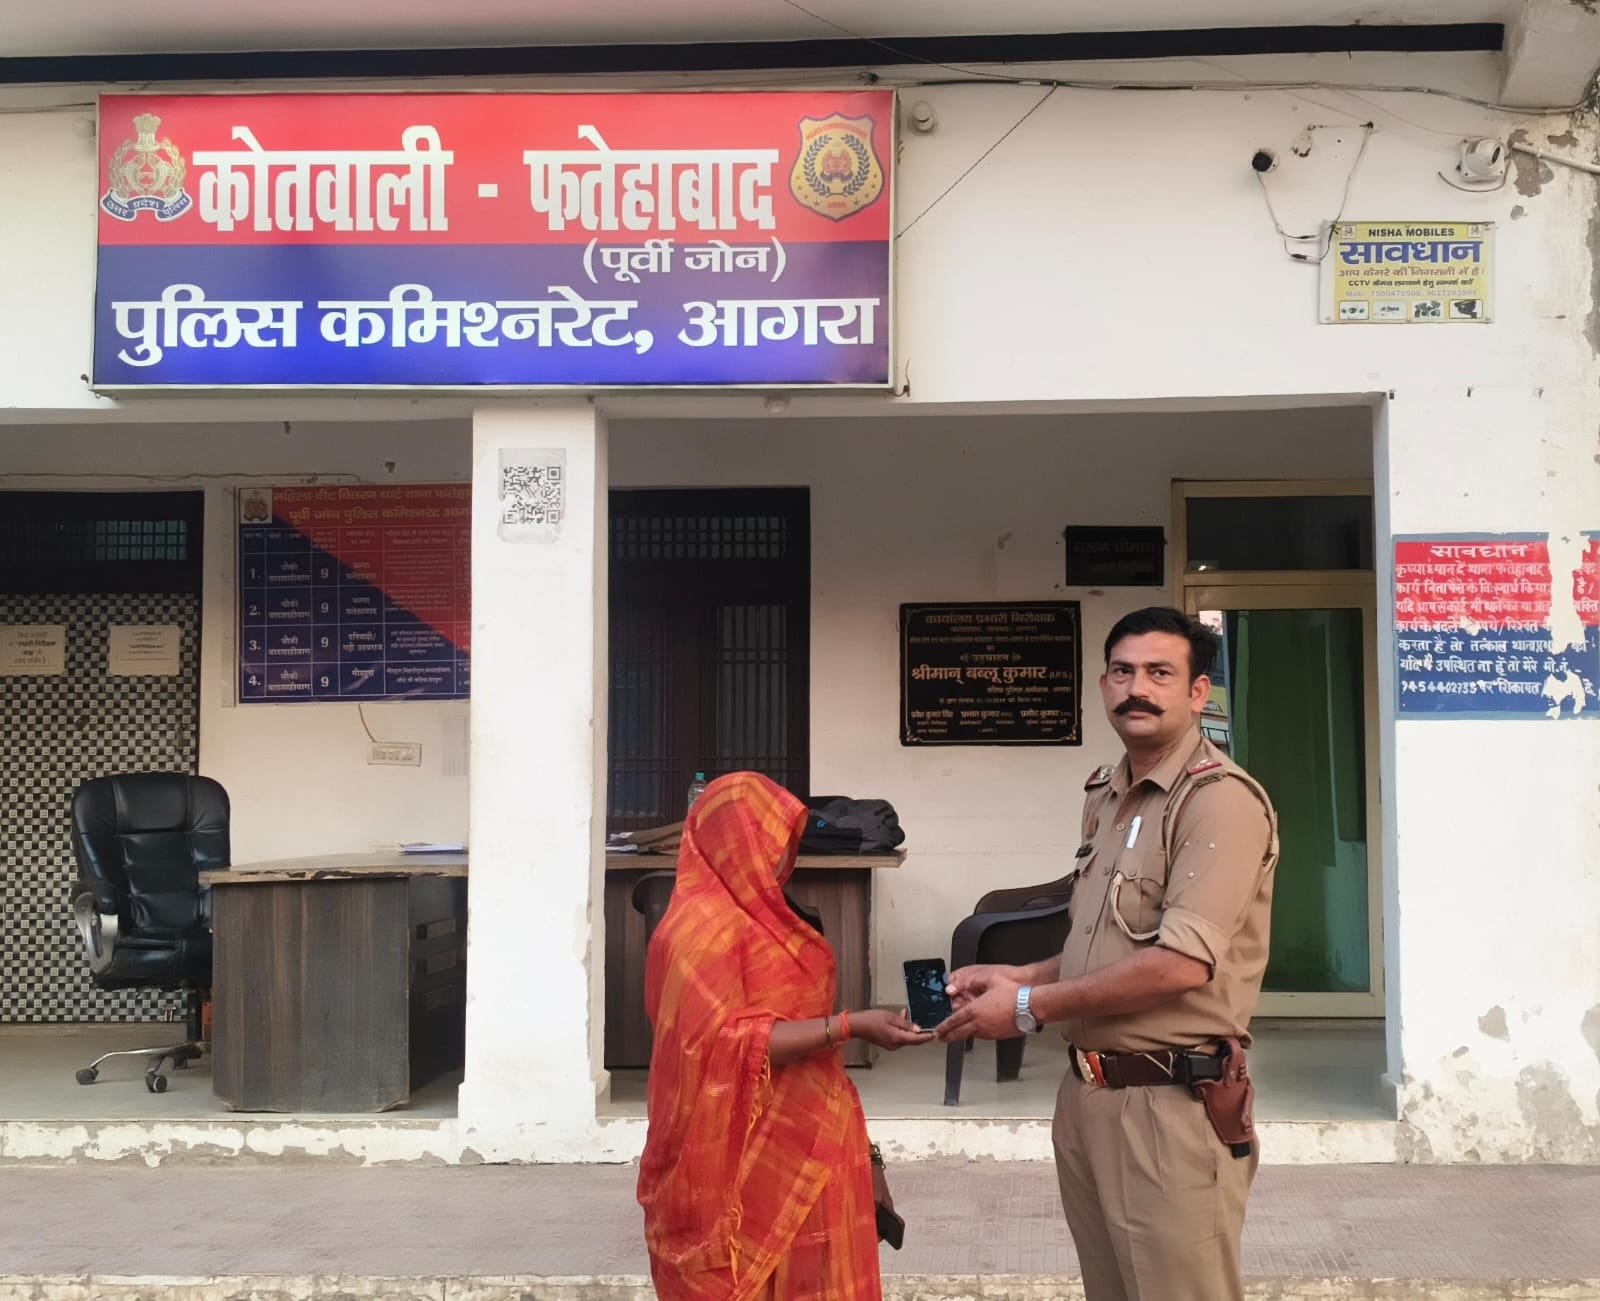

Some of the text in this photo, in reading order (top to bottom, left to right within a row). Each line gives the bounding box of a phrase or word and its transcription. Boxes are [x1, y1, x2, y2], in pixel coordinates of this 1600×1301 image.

[192, 125, 454, 231] कोतवाली
[523, 125, 779, 231] फतेहाबाद
[1368, 228, 1455, 237] NISHA MOBILES
[583, 236, 787, 283] (पूर्वी जोन)
[1339, 241, 1484, 265] सावधान
[1393, 266, 1408, 277] की
[111, 284, 881, 367] पुलिस कमिश्नरेट, आगरा
[1430, 544, 1528, 558] सावधान
[320, 567, 329, 579] 9
[320, 601, 329, 614] 9
[320, 636, 329, 648] 9
[1398, 639, 1433, 652] करता
[1433, 634, 1447, 654] है
[1449, 636, 1464, 652] तो
[1507, 655, 1521, 672] तो
[320, 675, 330, 687] 9
[912, 664, 964, 684] श्रीमान्
[966, 666, 1002, 684] बब्लू
[1003, 665, 1047, 683] कुमार
